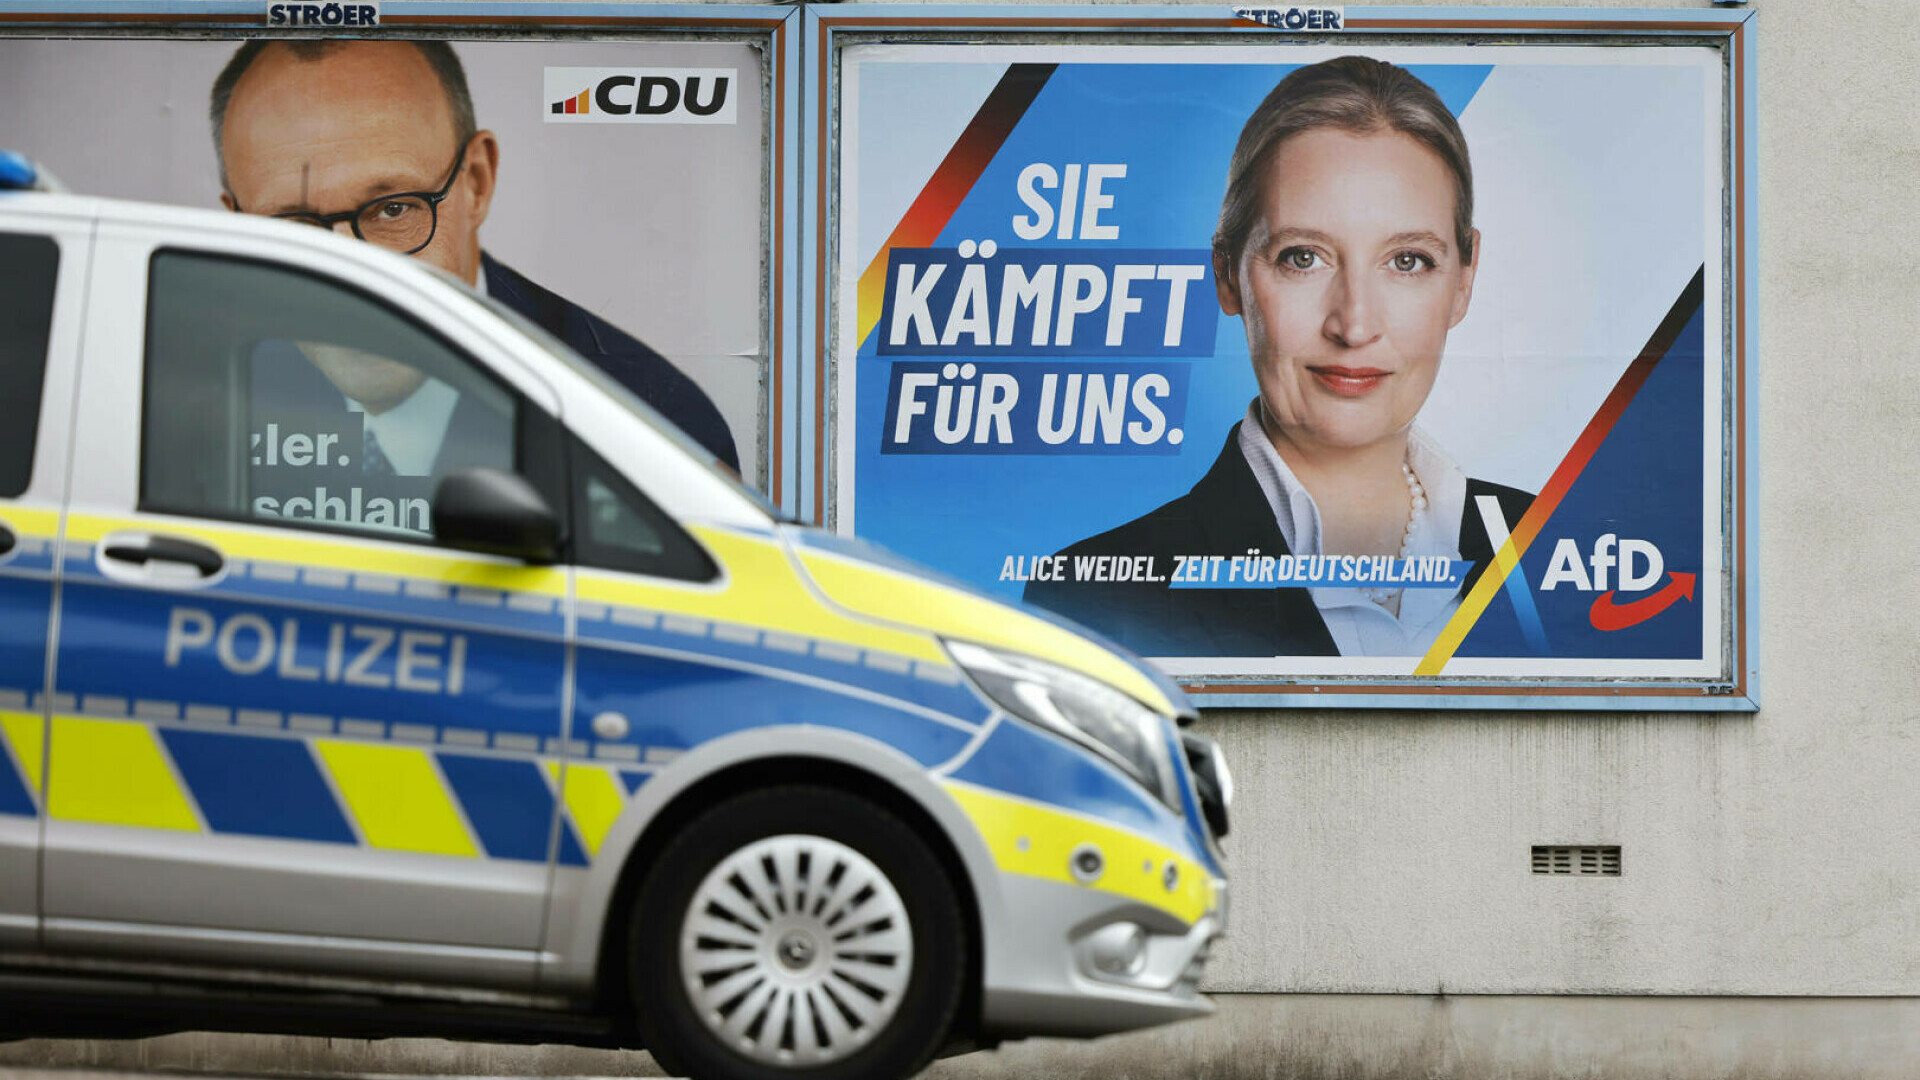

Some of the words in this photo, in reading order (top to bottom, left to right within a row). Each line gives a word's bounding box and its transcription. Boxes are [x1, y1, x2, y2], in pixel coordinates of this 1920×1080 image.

[270, 3, 376, 25] STRÖER
[595, 75, 729, 116] CDU
[1012, 162, 1128, 240] SIE
[889, 239, 1205, 346] KÄMPFT
[894, 363, 1019, 444] FÜR
[1037, 373, 1184, 445] UNS.
[999, 555, 1068, 581] ALICE
[1074, 555, 1166, 582] WEIDEL.
[1171, 555, 1225, 582] ZEIT
[1228, 548, 1276, 582] FÜR
[1277, 554, 1456, 582] DEUTSCHLAND.
[1540, 533, 1664, 591] AfD
[164, 606, 468, 695] POLIZEI
